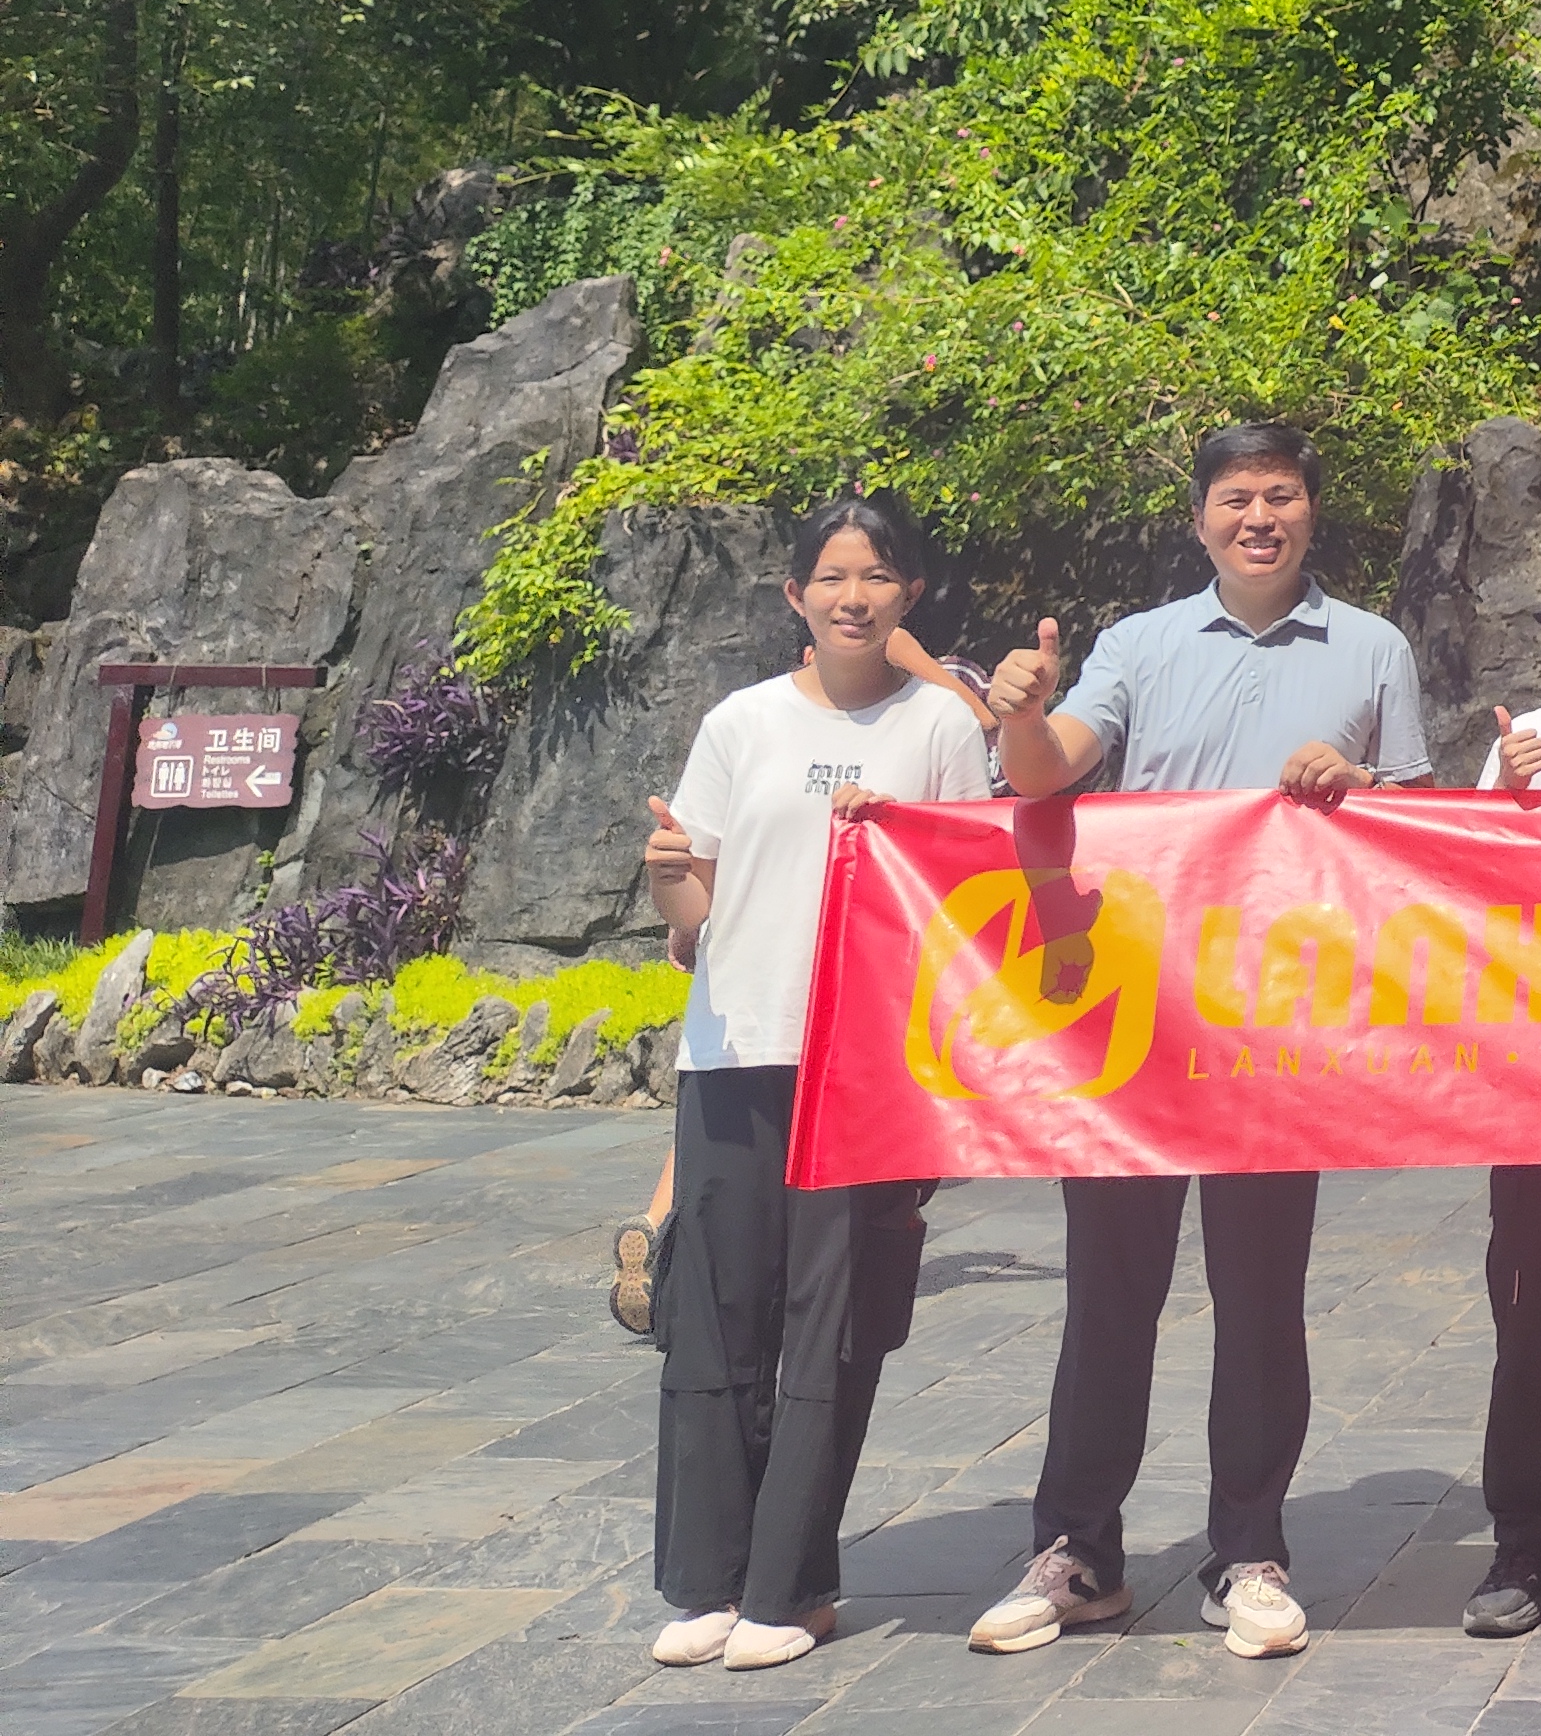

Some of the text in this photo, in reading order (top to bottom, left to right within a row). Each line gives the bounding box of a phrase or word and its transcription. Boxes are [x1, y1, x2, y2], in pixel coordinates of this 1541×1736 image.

[204, 727, 282, 753] 卫生间
[1187, 1042, 1481, 1081] LANXUAN
